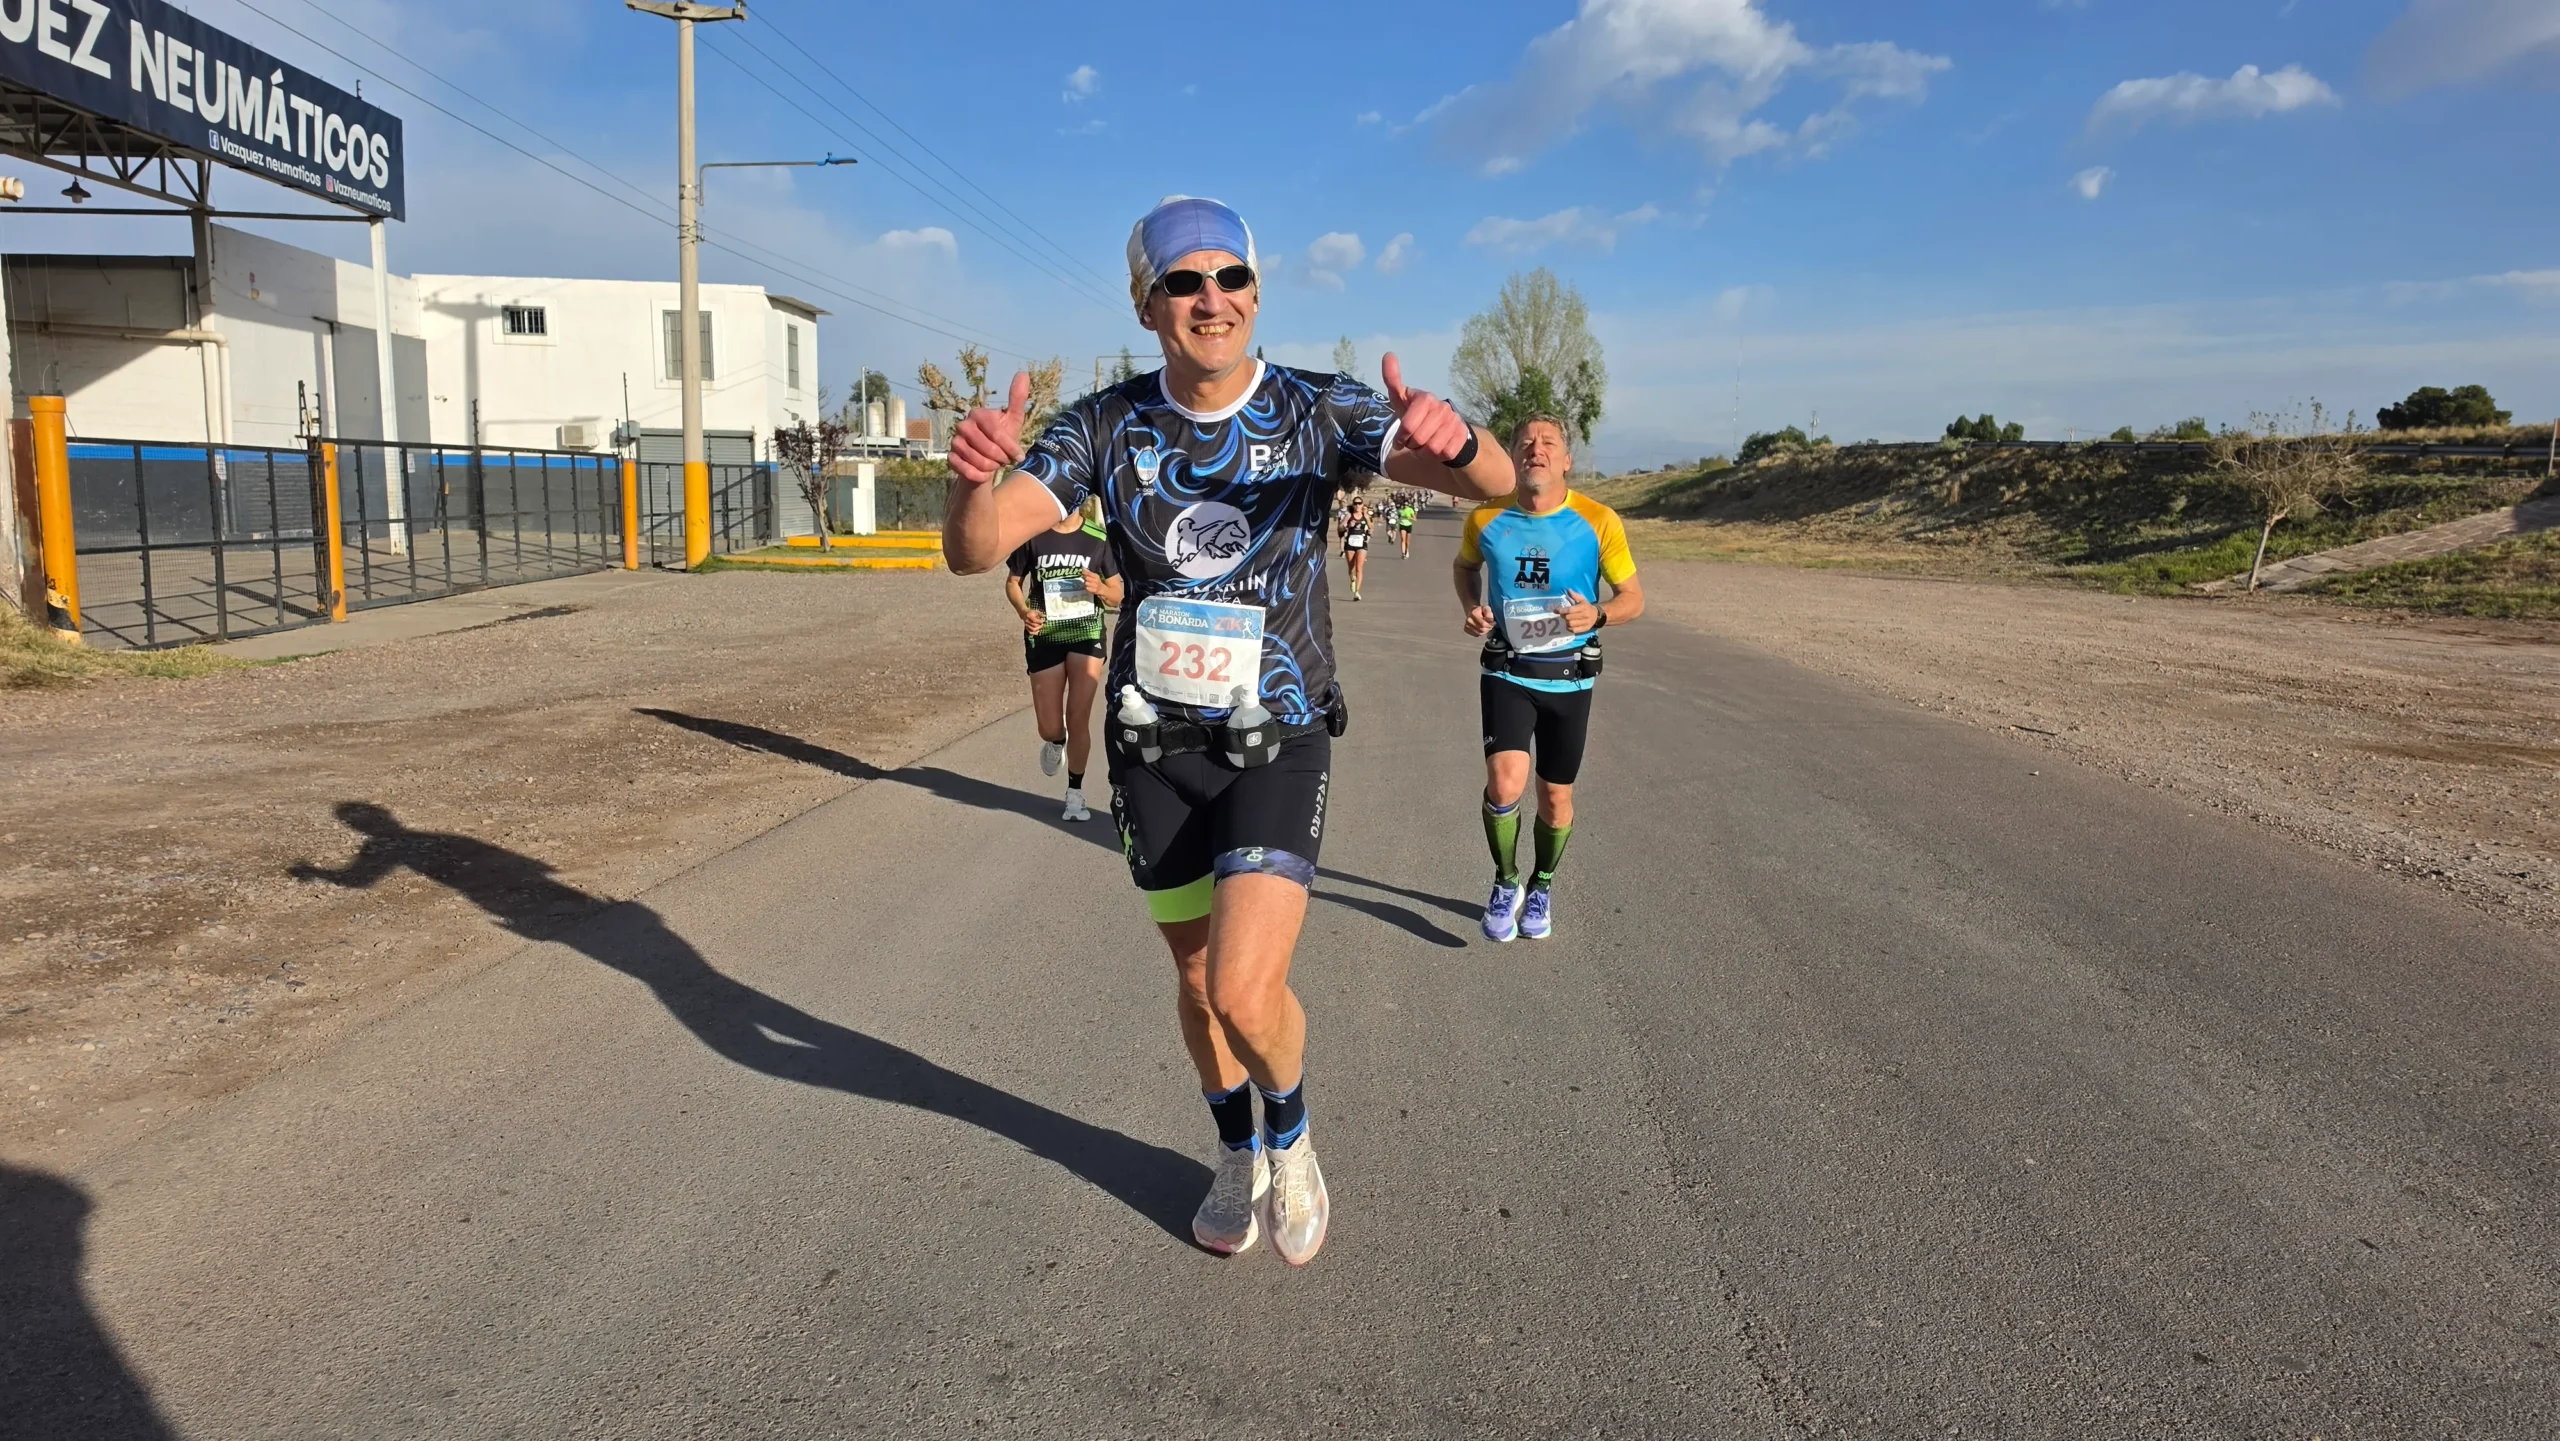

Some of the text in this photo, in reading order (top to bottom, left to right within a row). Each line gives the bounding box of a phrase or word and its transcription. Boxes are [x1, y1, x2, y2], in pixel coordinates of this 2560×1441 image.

[130, 19, 390, 189] NEUMÁTICOS
[220, 135, 265, 166] Vazquez
[265, 155, 322, 187] neumaticos
[333, 178, 392, 213] Vazneumaticos
[1035, 554, 1091, 570] JUNIN
[1037, 566, 1083, 582] Runnin
[1158, 614, 1209, 629] BONARDA
[1520, 618, 1561, 640] 292
[1159, 641, 1232, 683] 232
